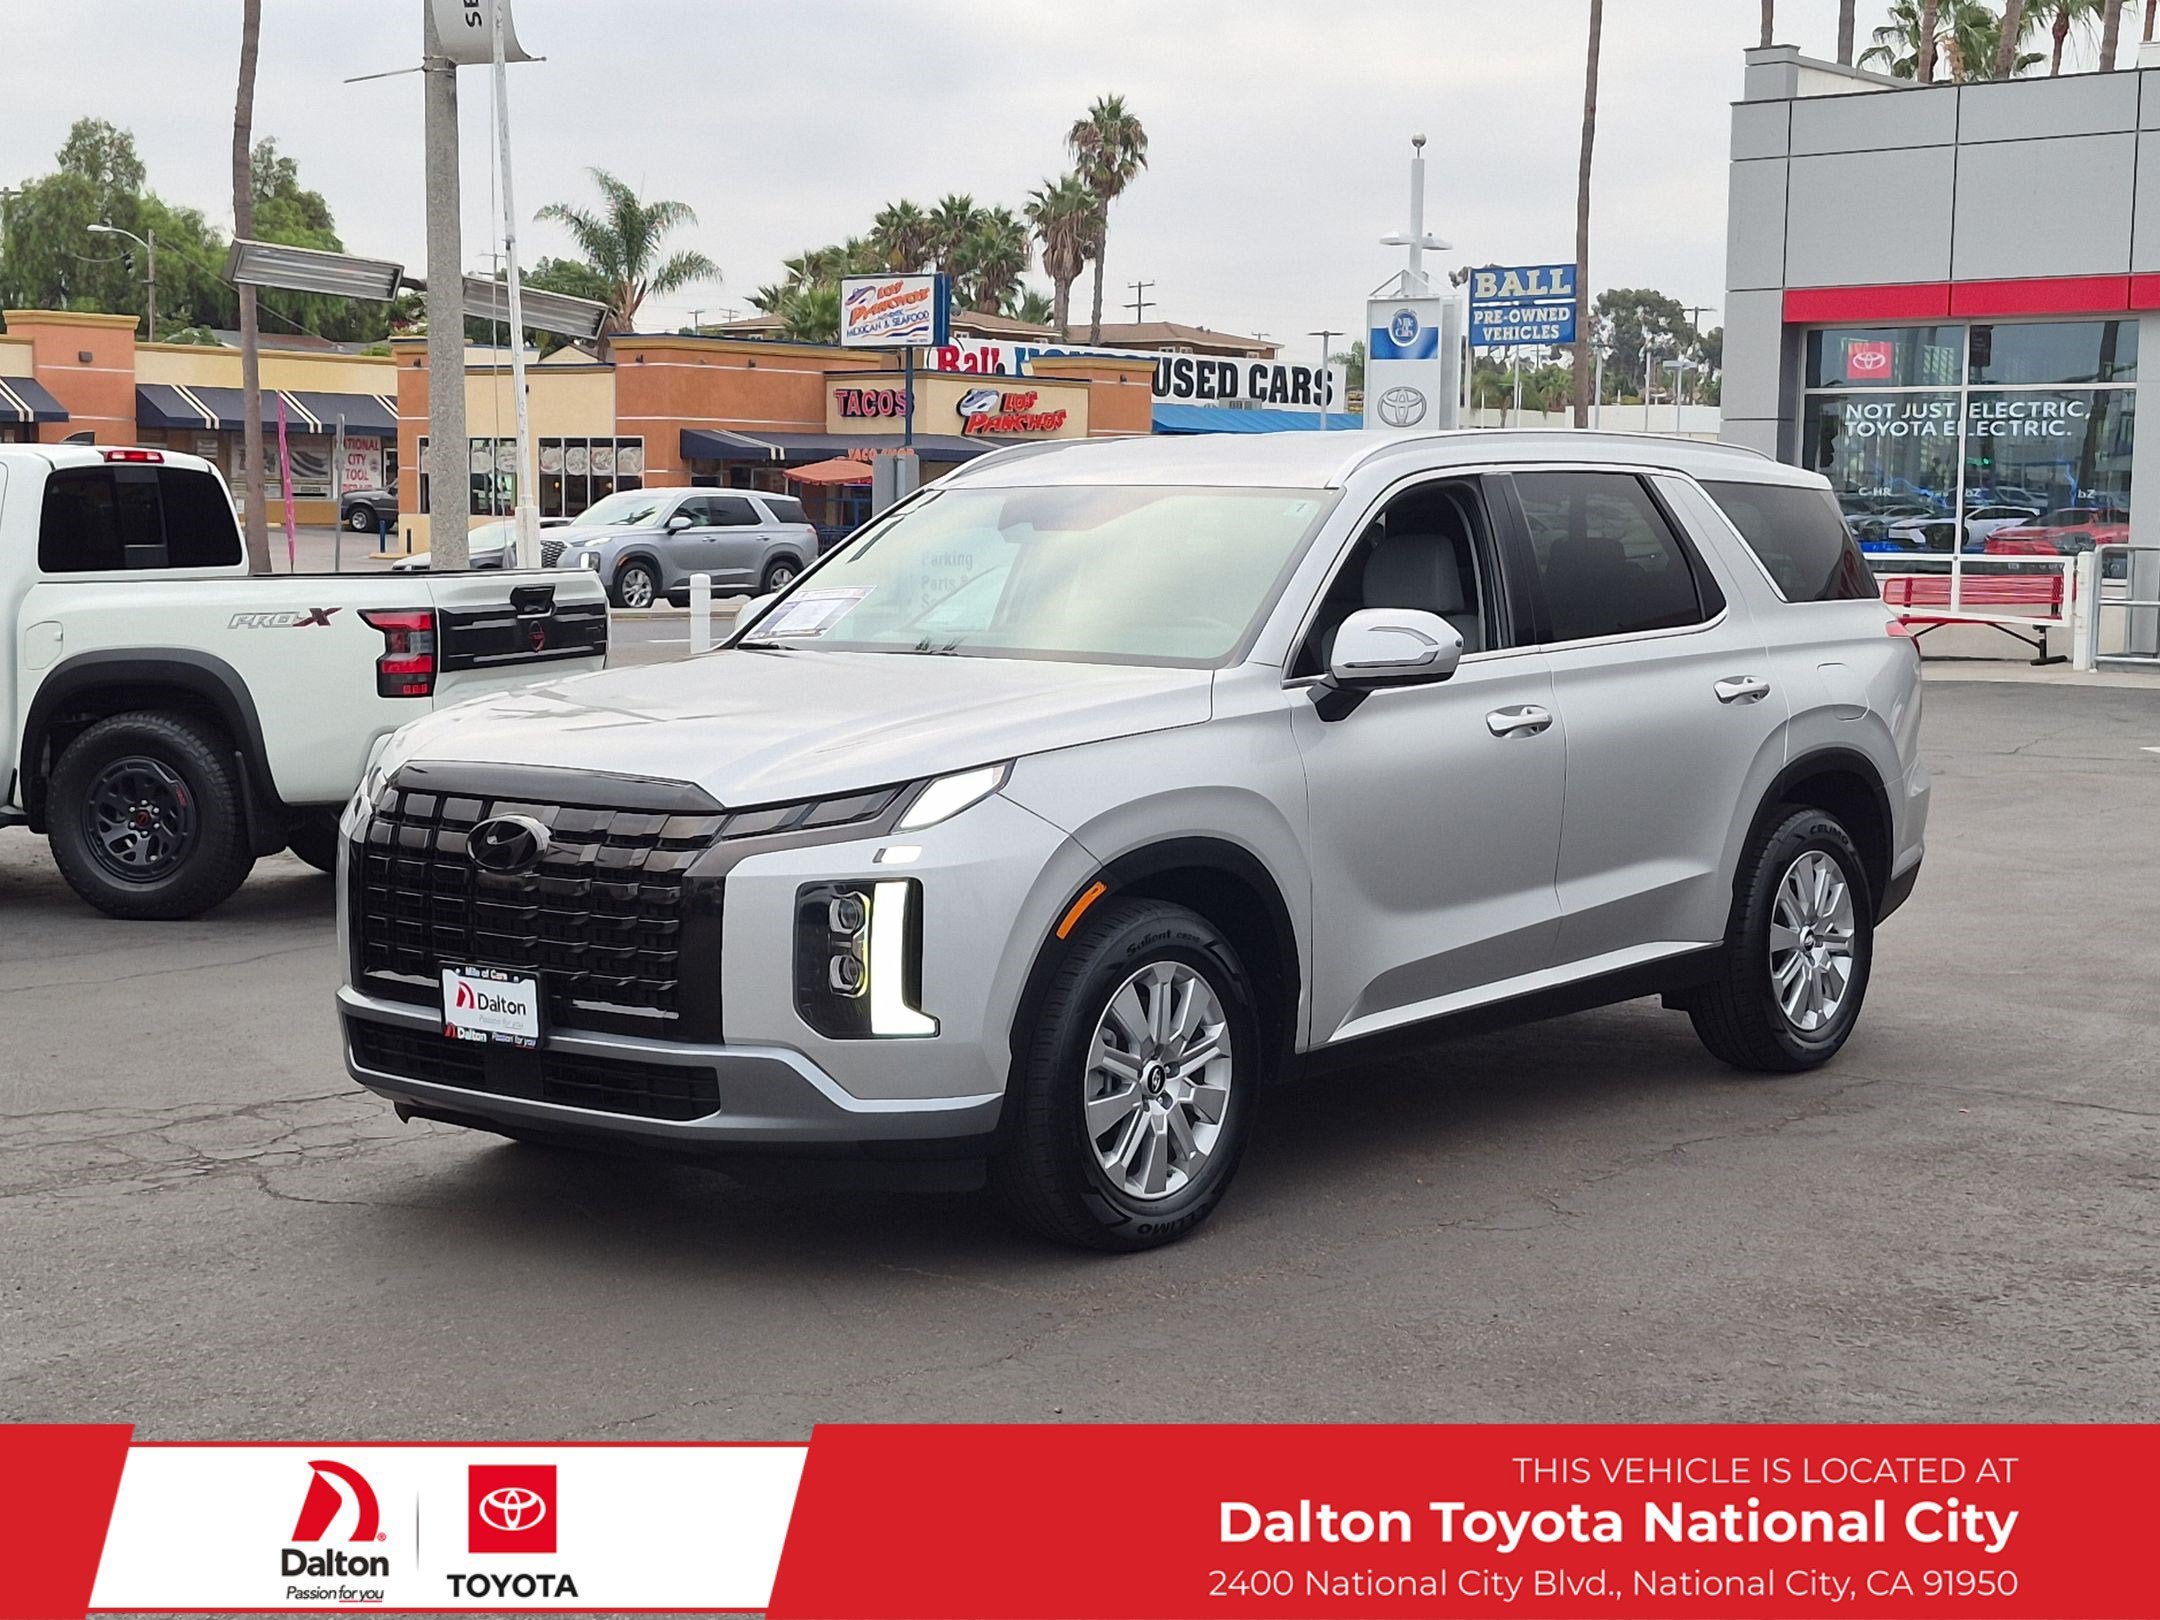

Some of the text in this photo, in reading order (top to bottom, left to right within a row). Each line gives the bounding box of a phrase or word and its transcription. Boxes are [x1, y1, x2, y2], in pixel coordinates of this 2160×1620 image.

[1474, 269, 1571, 298] BALL
[847, 322, 882, 338] MEXICAN
[892, 310, 930, 327] SEAFOOD
[1473, 307, 1570, 325] PRE-OWNED
[1482, 325, 1560, 341] VEHICLES
[1153, 356, 1239, 398] USED
[1249, 364, 1333, 405] CARS
[834, 388, 908, 418] TACOS
[1002, 391, 1038, 412] LOS
[1846, 401, 2091, 420] NOT JUST ELECTRIC,
[965, 409, 1067, 435] PANCHOS
[1844, 420, 1937, 437] TOYOTA
[348, 453, 366, 466] CITY
[345, 468, 369, 481] TOOL
[477, 992, 527, 1016] Dalton
[457, 1026, 487, 1043] Dalton
